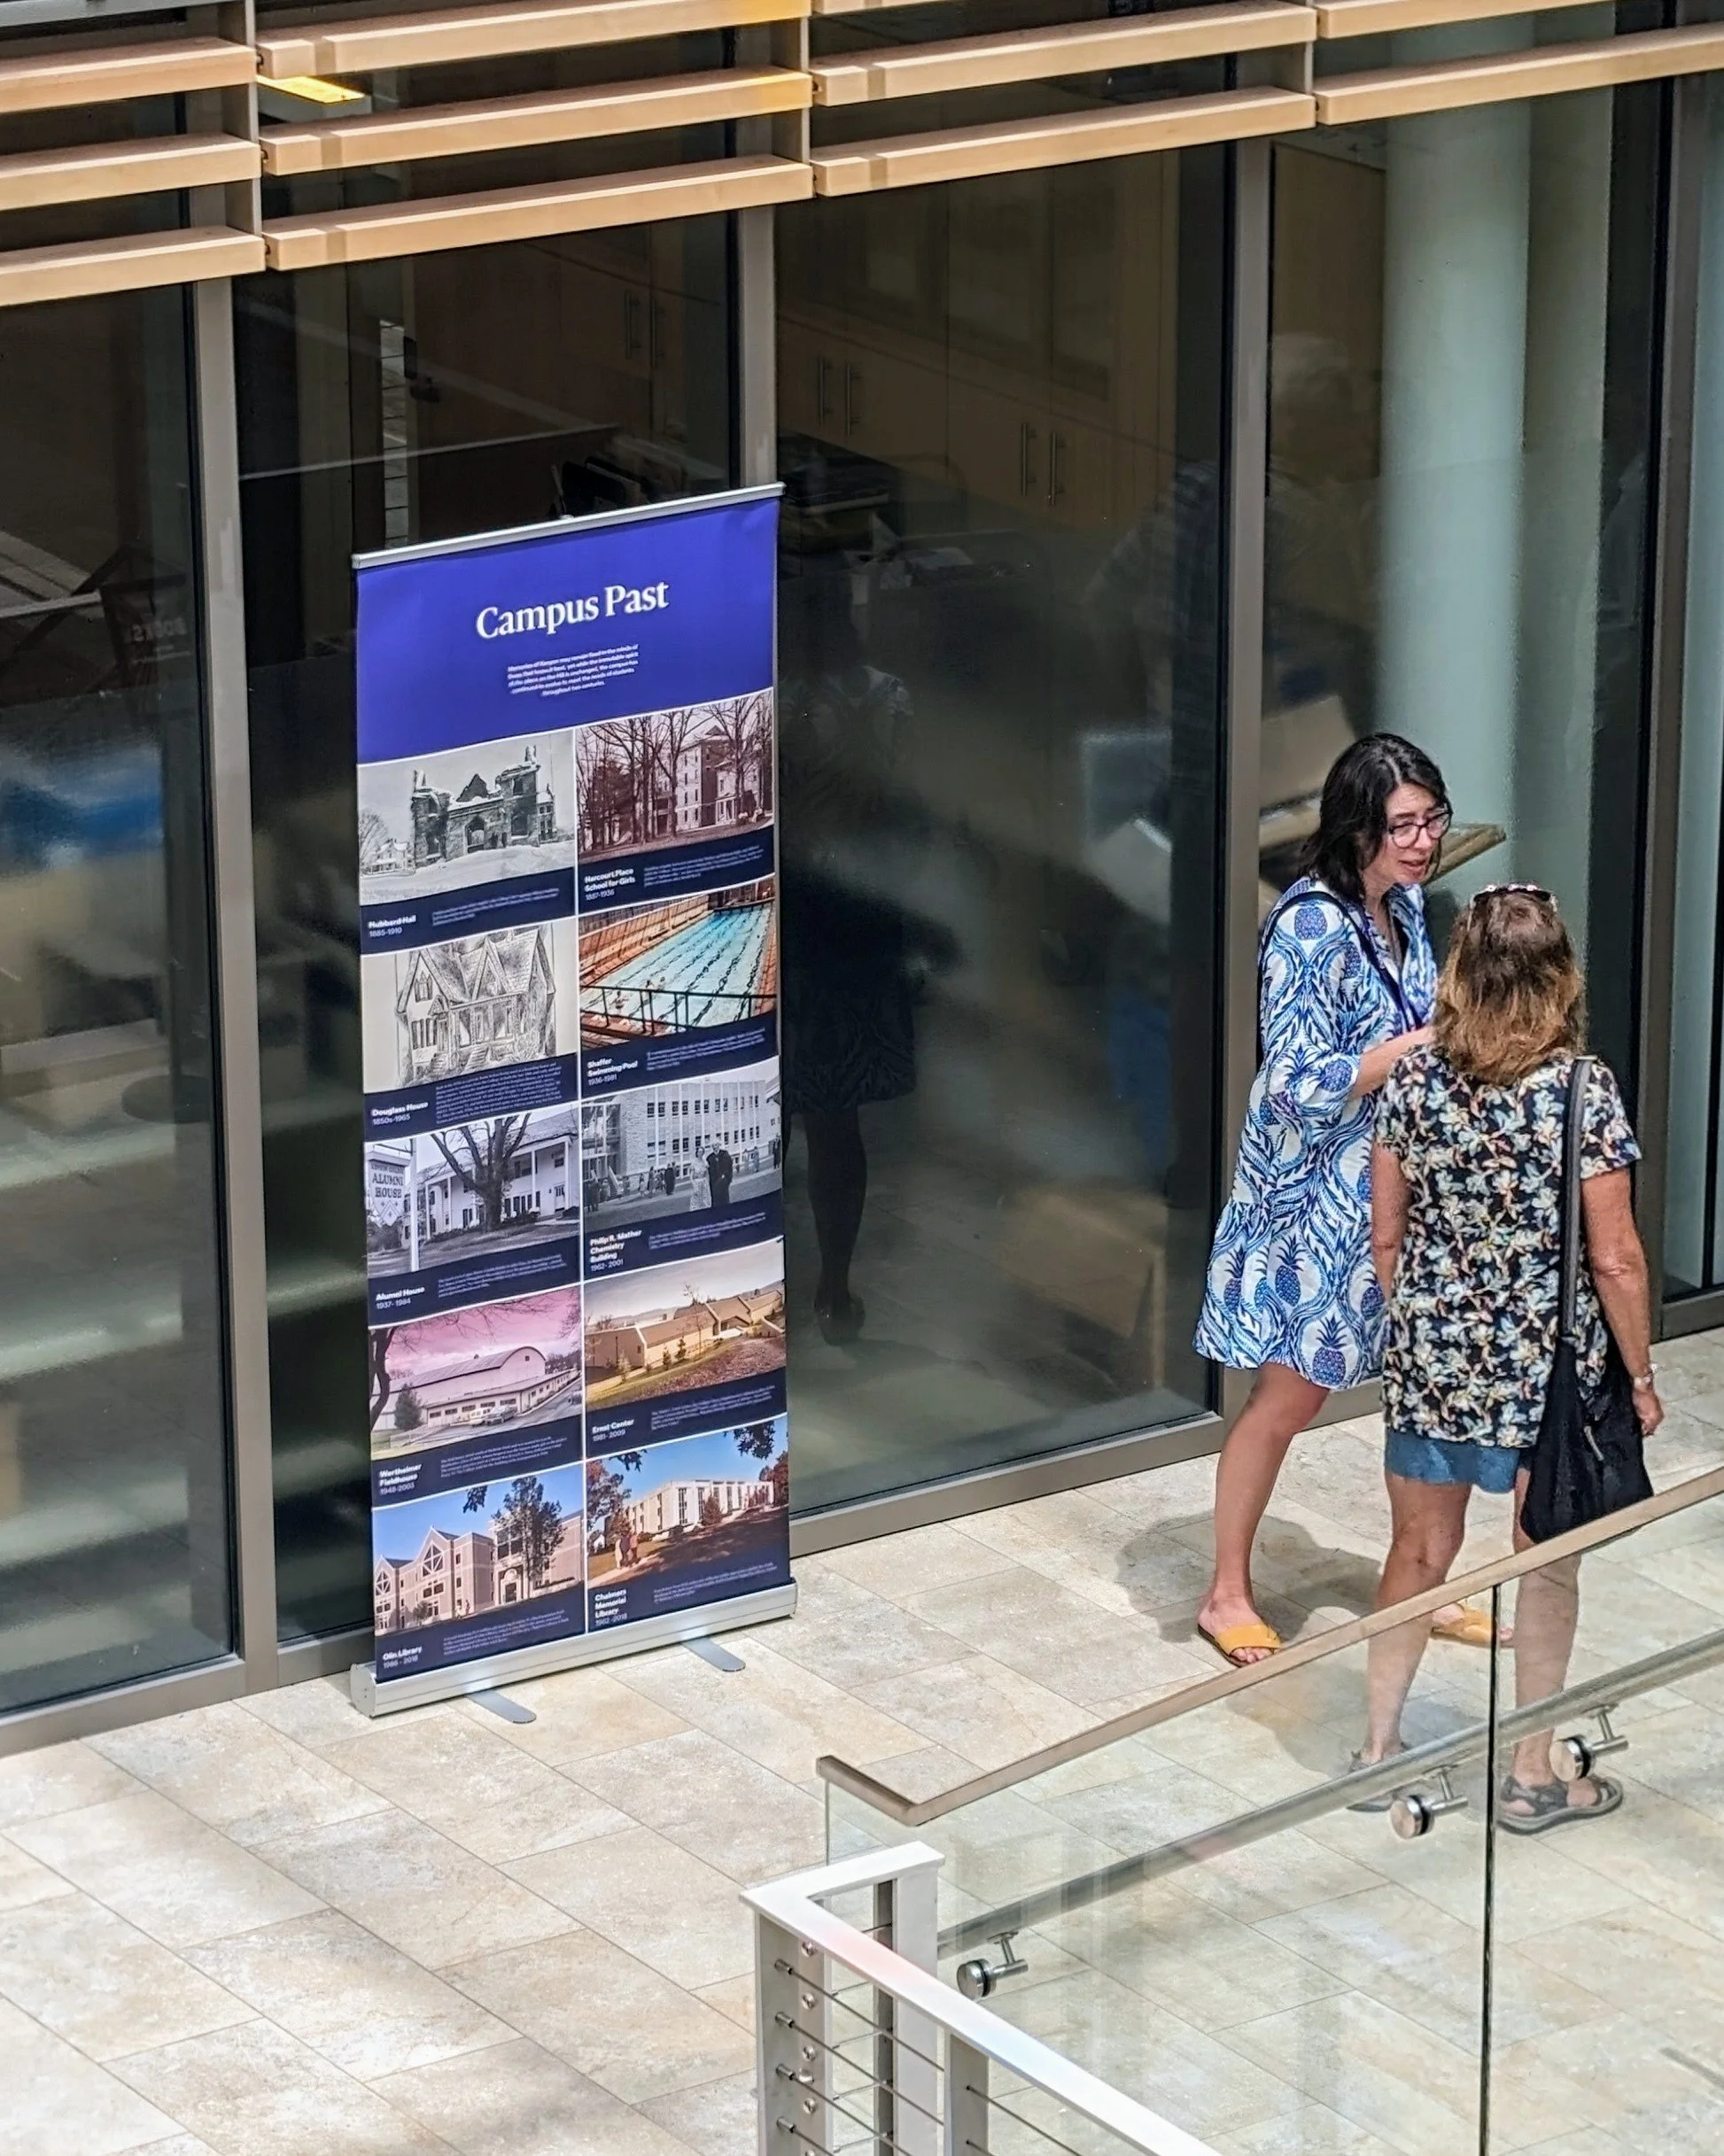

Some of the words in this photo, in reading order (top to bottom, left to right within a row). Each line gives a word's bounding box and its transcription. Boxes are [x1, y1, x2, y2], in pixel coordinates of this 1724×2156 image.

[476, 595, 599, 639] Campus
[604, 582, 669, 617] Past
[585, 872, 615, 884] Harcourt
[615, 868, 634, 878] Place
[585, 881, 608, 893] School
[608, 879, 619, 888] for
[619, 875, 636, 885] Girls
[369, 918, 401, 929] Hubbard
[401, 915, 416, 924] Hall
[587, 1057, 613, 1068] Shaffer
[588, 1064, 622, 1077] Swimming
[622, 1060, 639, 1071] Pool
[371, 1105, 405, 1117] Douglass
[407, 1101, 429, 1112] House
[371, 1173, 404, 1186] ALUMNI
[375, 1187, 402, 1198] HOUSE
[590, 1235, 610, 1247] Philip
[617, 1229, 642, 1241] Mather
[590, 1242, 625, 1255] Chemistry
[590, 1252, 618, 1265] Building
[376, 1290, 402, 1301] Alumni
[403, 1285, 425, 1296] House
[592, 1423, 610, 1434] Ernst
[610, 1418, 635, 1430] Center
[379, 1463, 423, 1477] Wertheimer
[379, 1473, 418, 1486] Fieldhouse
[594, 1589, 627, 1601] Chalmers
[594, 1597, 627, 1610] Memorial
[594, 1607, 619, 1619] Library
[382, 1650, 398, 1661] Olin
[398, 1646, 423, 1658] Library
